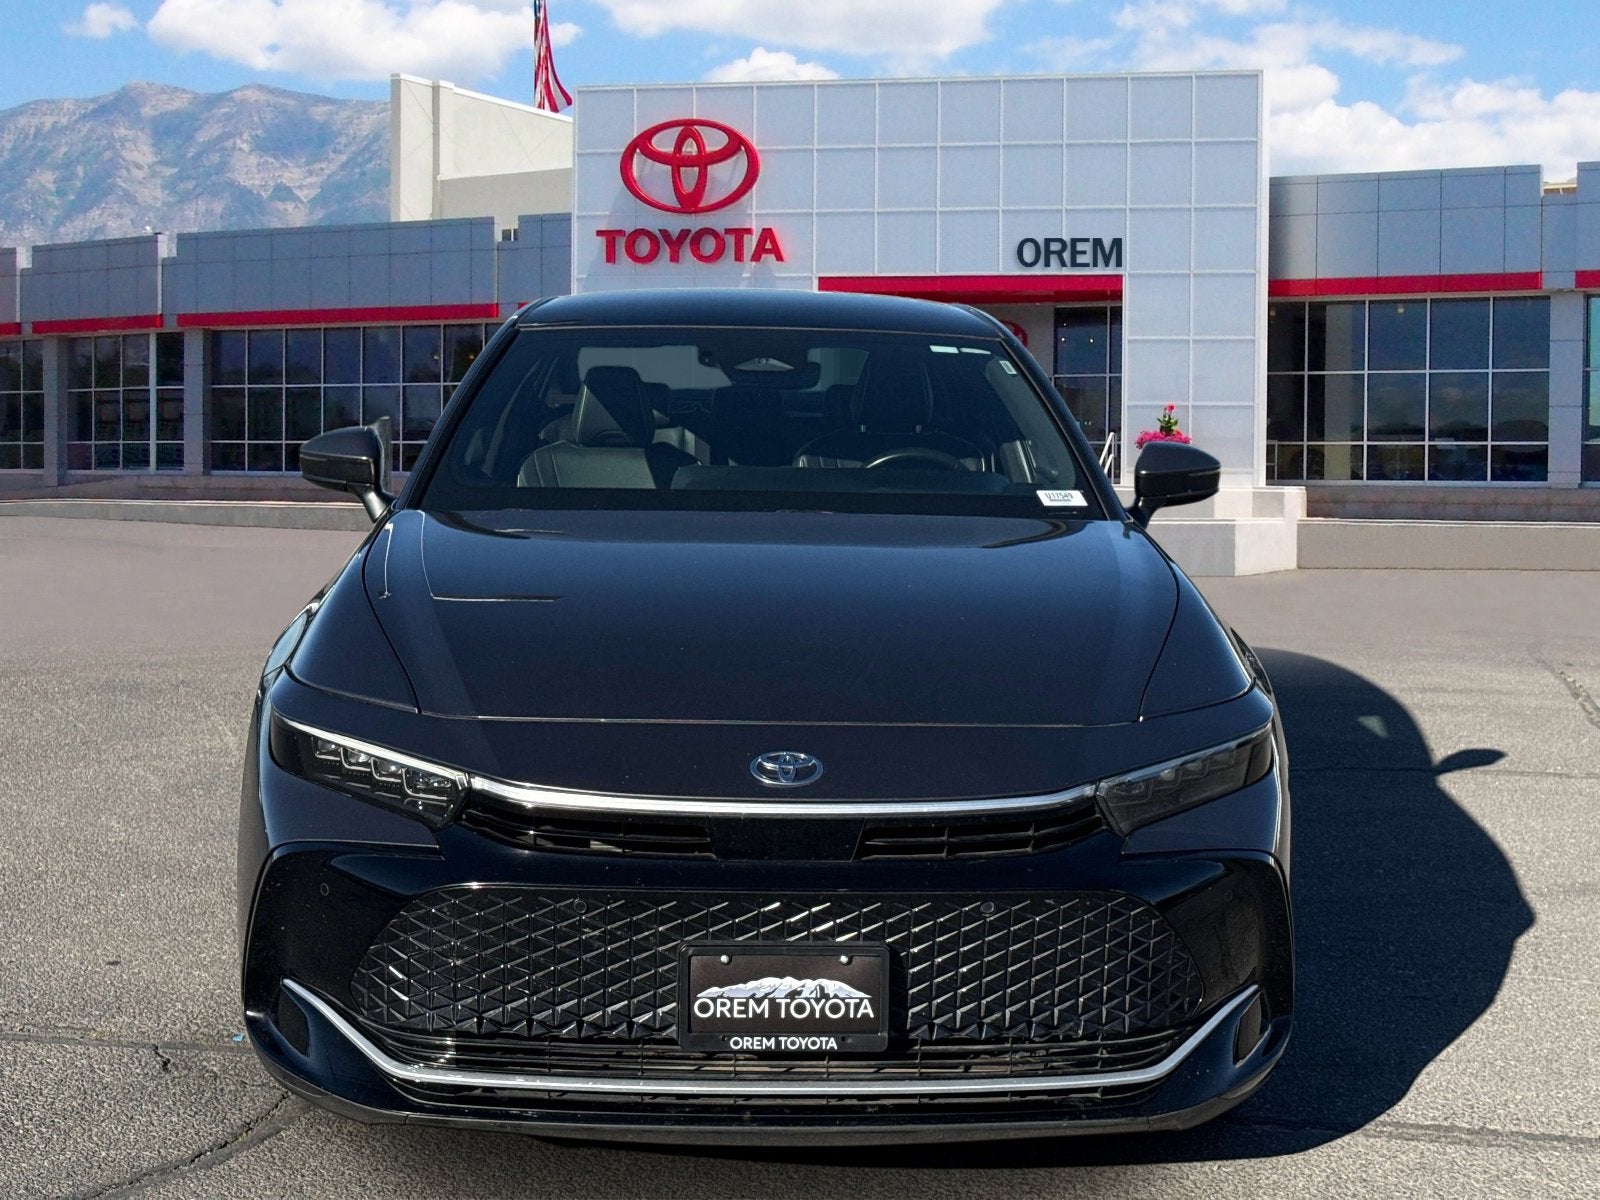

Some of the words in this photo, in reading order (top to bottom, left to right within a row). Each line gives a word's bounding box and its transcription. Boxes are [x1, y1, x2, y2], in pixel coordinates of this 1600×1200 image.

[596, 227, 785, 264] TOYOTA
[1016, 237, 1123, 268] OREM
[693, 998, 769, 1019] OREM
[776, 998, 875, 1019] TOYOTA
[729, 1036, 776, 1050] OREM
[778, 1036, 838, 1050] TOYOTA
